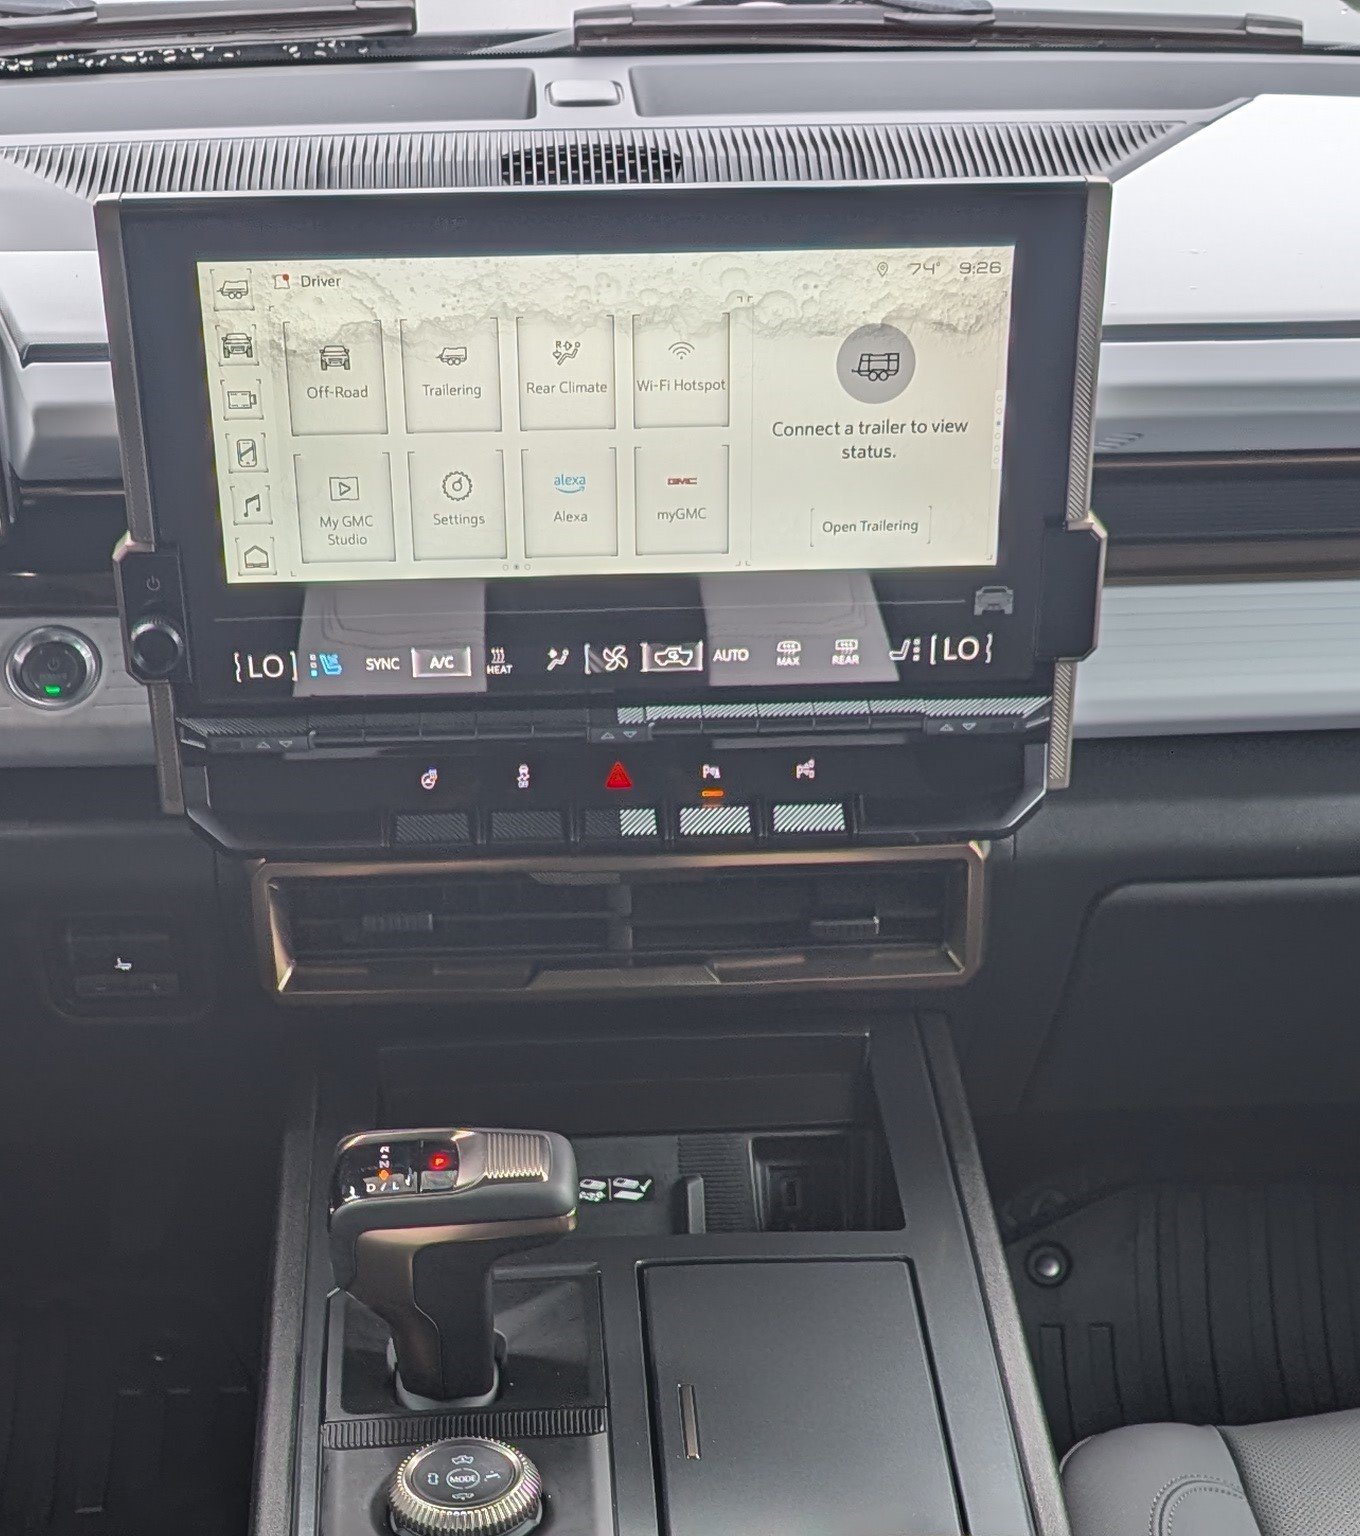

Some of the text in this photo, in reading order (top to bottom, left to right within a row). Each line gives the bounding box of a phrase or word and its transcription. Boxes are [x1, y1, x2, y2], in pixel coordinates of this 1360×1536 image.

[959, 261, 1002, 275] 9:26
[300, 275, 341, 288] Driver
[307, 385, 368, 399] Off-Road
[422, 383, 482, 398] Trailering
[526, 380, 607, 394] Rear Climate
[636, 378, 726, 393] Wi-Fi Hotspot
[772, 419, 969, 437] Connect a trailer to view
[841, 445, 897, 459] status.
[553, 474, 586, 486] alexa
[667, 477, 698, 486] GMC
[433, 513, 486, 528] Settings
[553, 510, 588, 523] Alexa
[657, 507, 707, 523] myGMC
[319, 515, 374, 530] My GMC
[822, 519, 919, 535] Open Trailering
[328, 533, 368, 546] Studio
[712, 648, 749, 662] AUTO
[943, 636, 980, 662] LO
[247, 654, 285, 678] LO
[365, 657, 401, 671] SYNC
[429, 656, 455, 669] A/C
[776, 655, 801, 667] MAX
[832, 654, 860, 665] REAR
[486, 664, 513, 675] HEAT
[449, 1474, 477, 1484] MODE
